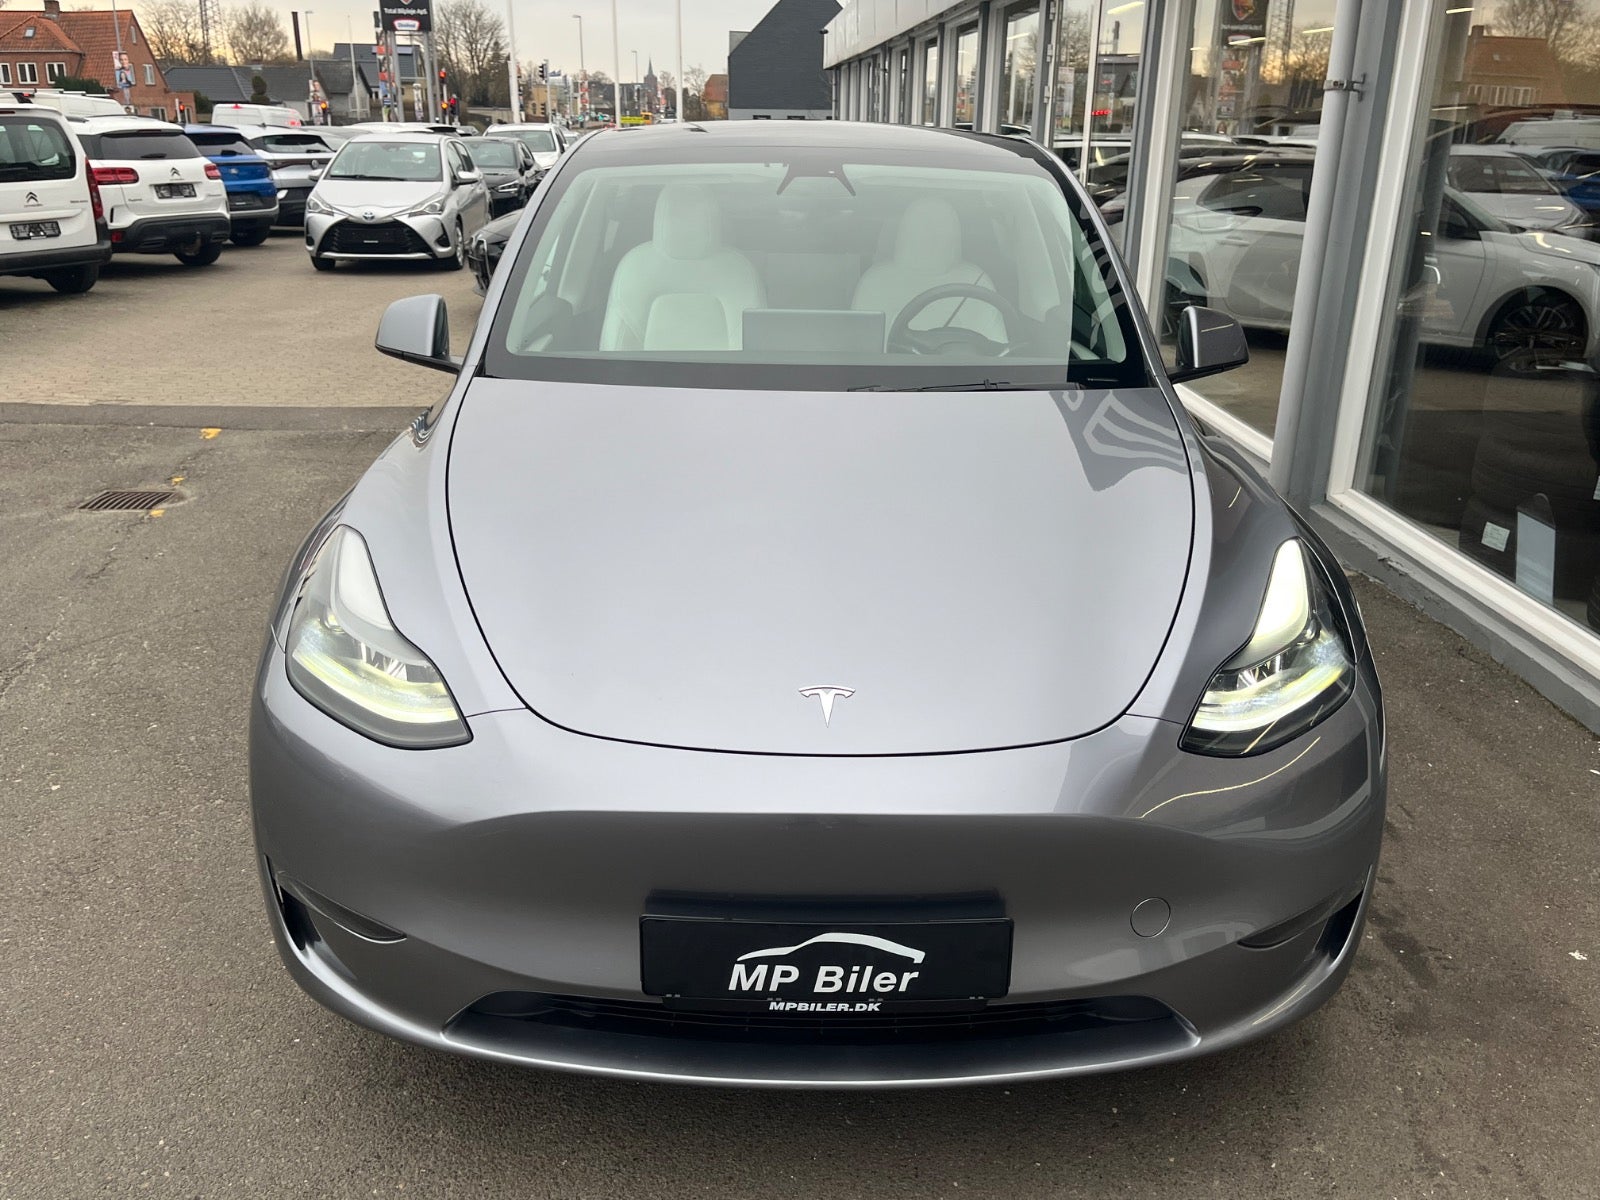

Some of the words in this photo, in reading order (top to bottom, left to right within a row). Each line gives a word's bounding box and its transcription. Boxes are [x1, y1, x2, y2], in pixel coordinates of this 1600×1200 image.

[728, 963, 800, 992] MP
[813, 965, 920, 993] Biler
[769, 1001, 882, 1012] MPBILER.DK
